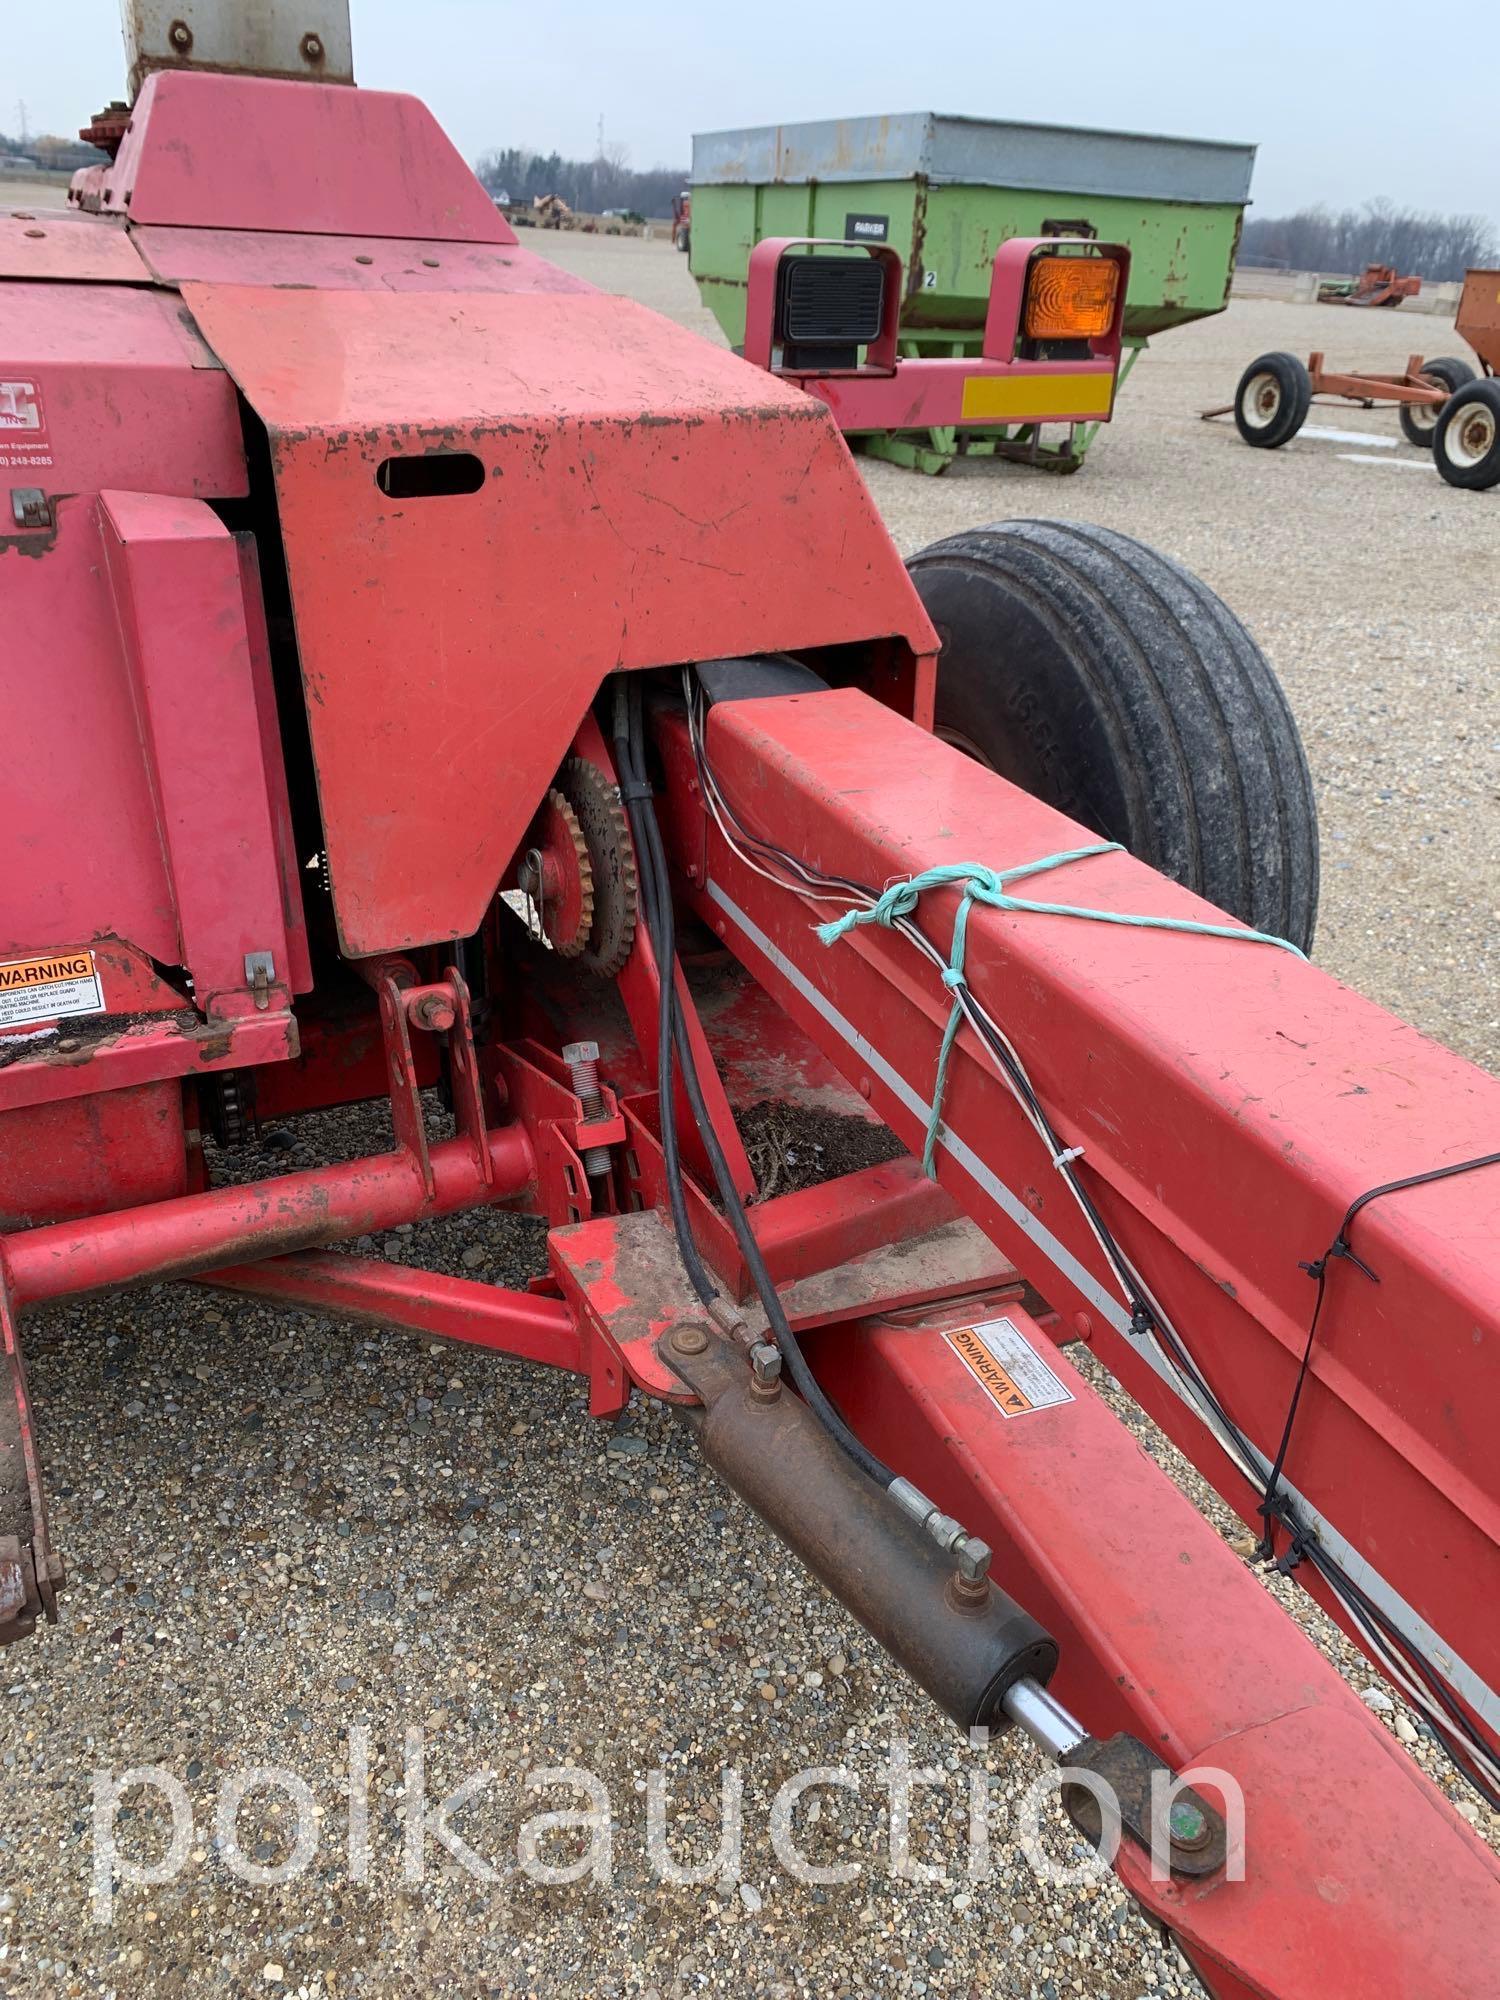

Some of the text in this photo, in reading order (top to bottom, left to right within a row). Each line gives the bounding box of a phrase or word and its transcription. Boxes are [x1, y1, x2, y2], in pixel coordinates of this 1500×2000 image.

[854, 221, 885, 235] PARKER
[926, 271, 935, 287] 2
[10, 442, 49, 450] Equipment
[955, 1333, 1010, 1395] WARNING
